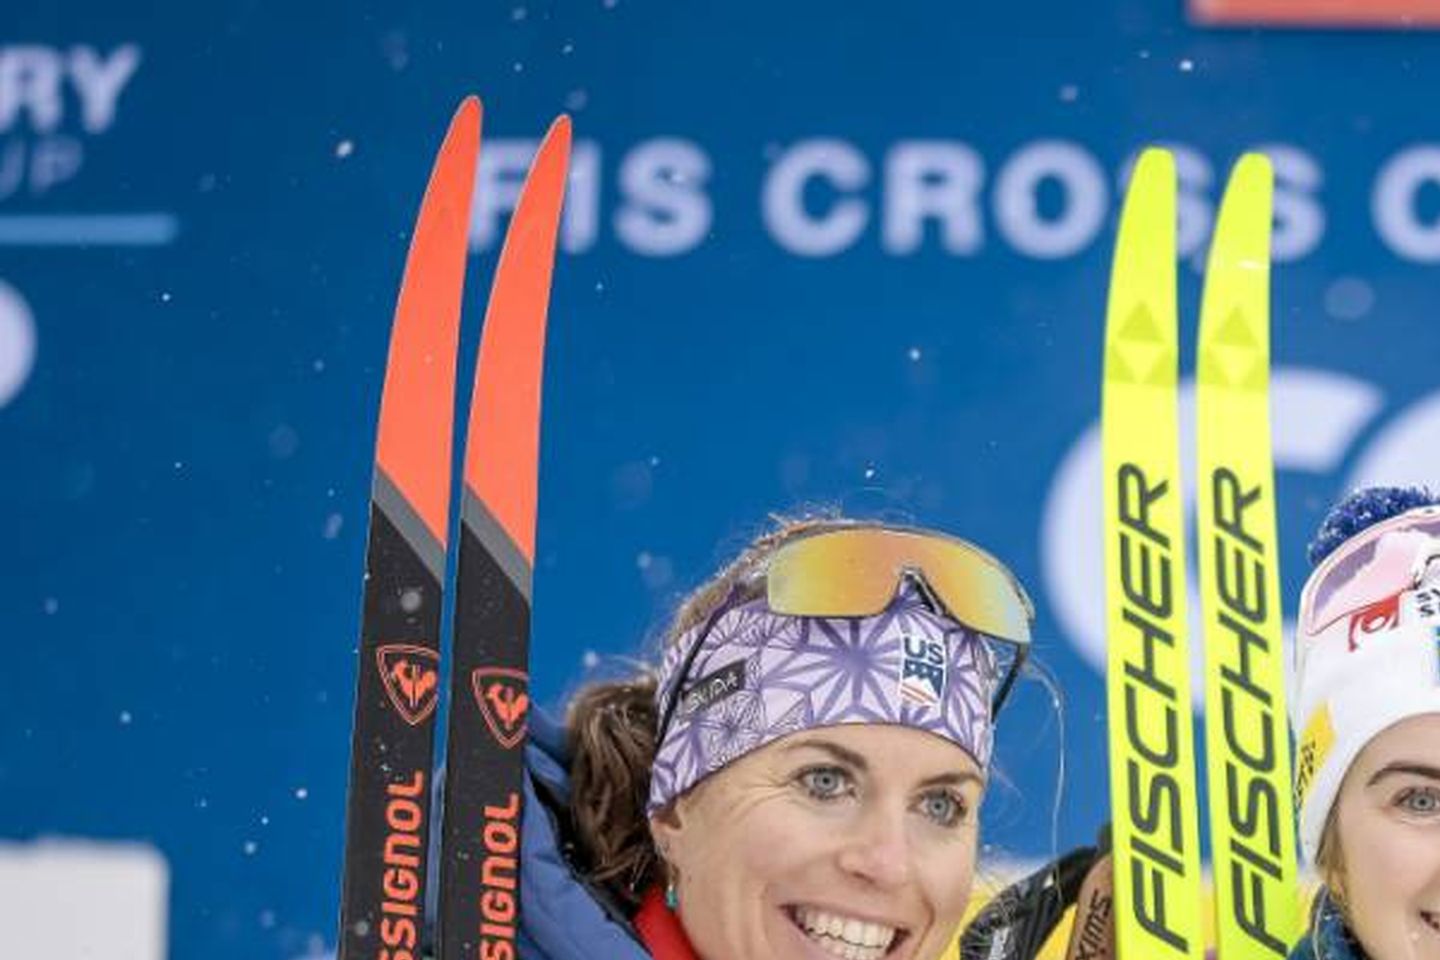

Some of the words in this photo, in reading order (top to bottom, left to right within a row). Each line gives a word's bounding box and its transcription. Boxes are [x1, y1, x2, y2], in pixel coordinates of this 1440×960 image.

[469, 137, 713, 257] FIS
[762, 137, 1325, 260] CROSS
[1116, 463, 1189, 954] FISCHER
[1212, 466, 1288, 958] FISCHER
